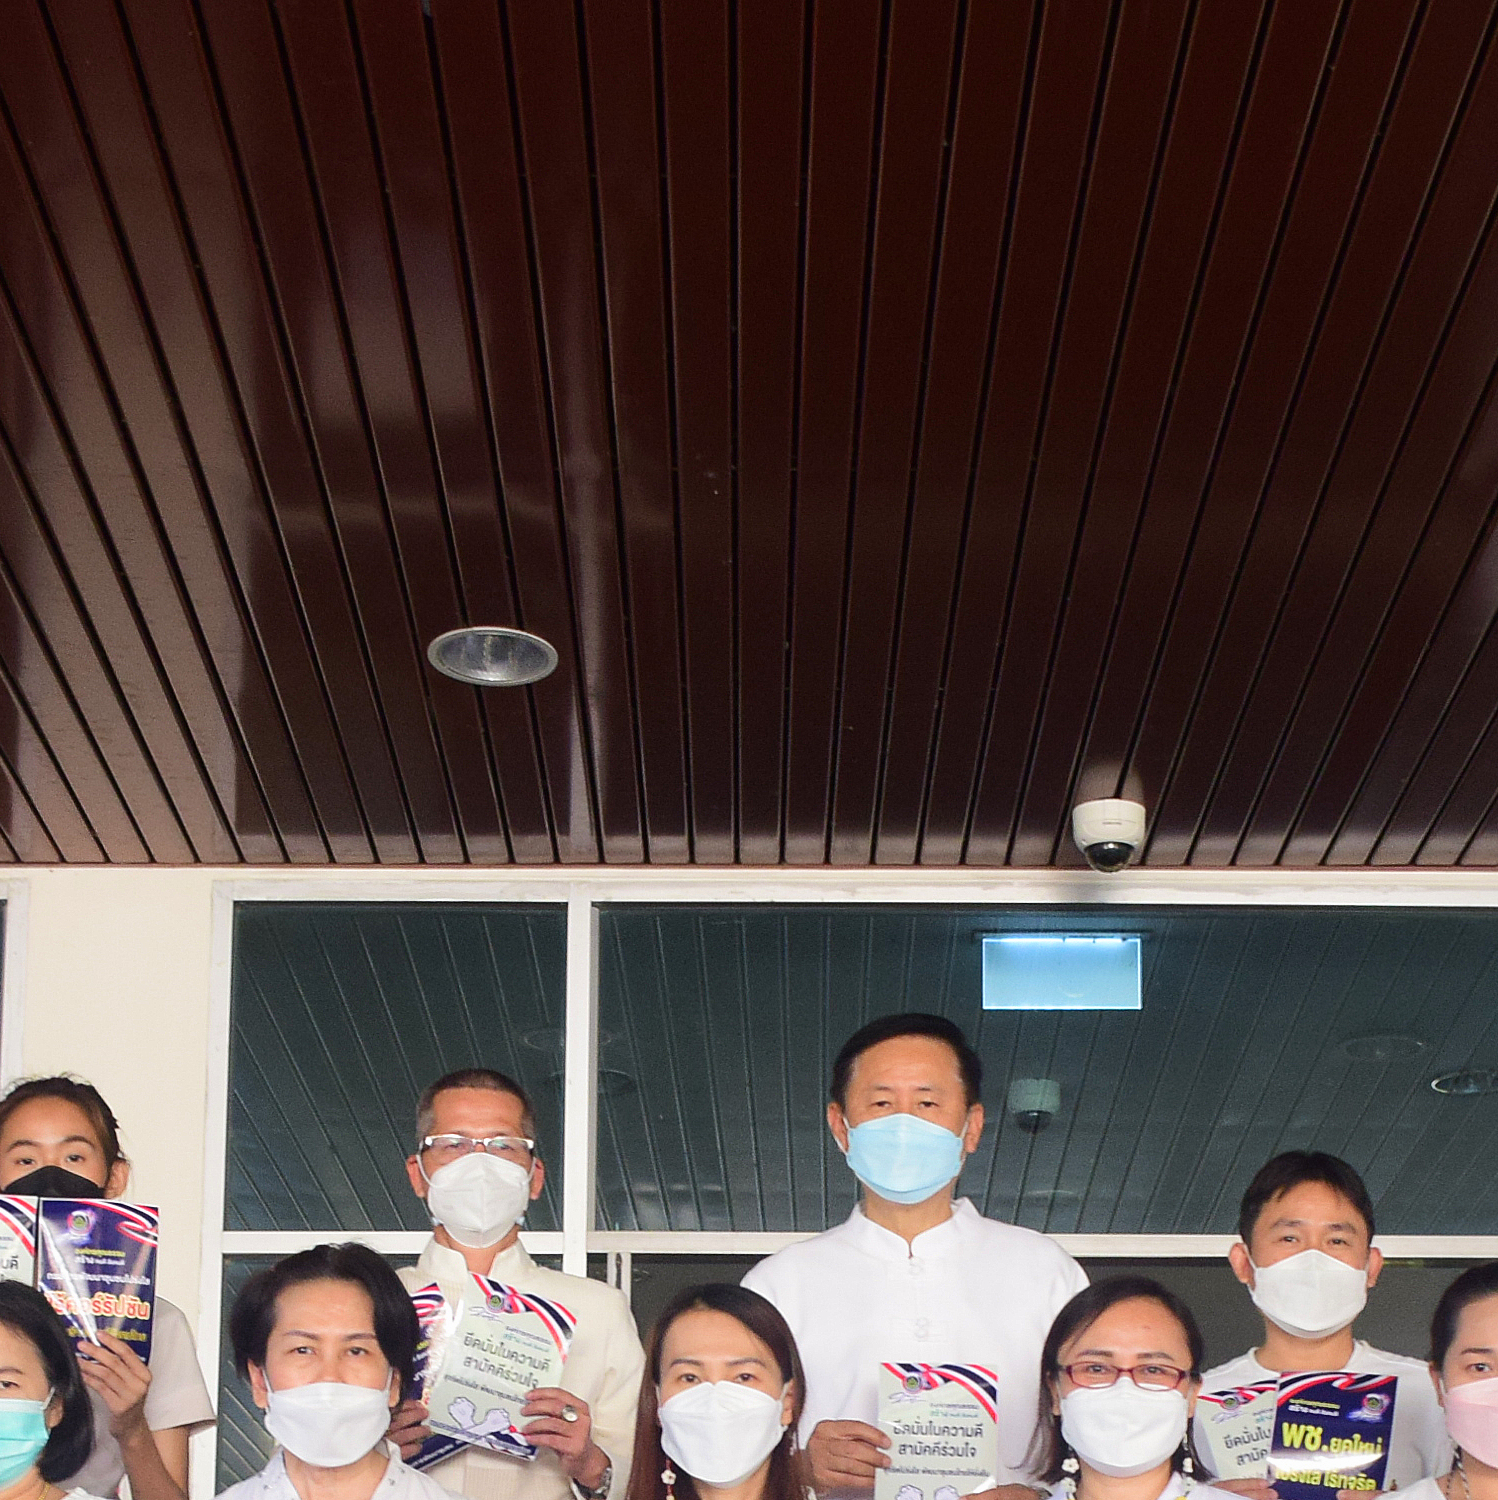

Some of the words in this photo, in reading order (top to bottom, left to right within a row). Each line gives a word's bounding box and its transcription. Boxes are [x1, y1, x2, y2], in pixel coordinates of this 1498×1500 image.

[463, 1332, 551, 1372] ยึดมั่นในความดี
[463, 1355, 539, 1389] สามัคคีร่วมใจ
[893, 1416, 984, 1438] ยึดมั่นในความดี
[1223, 1426, 1271, 1449] ยึดมั่นใน
[898, 1441, 977, 1458] สามัคคีร่วมใจ
